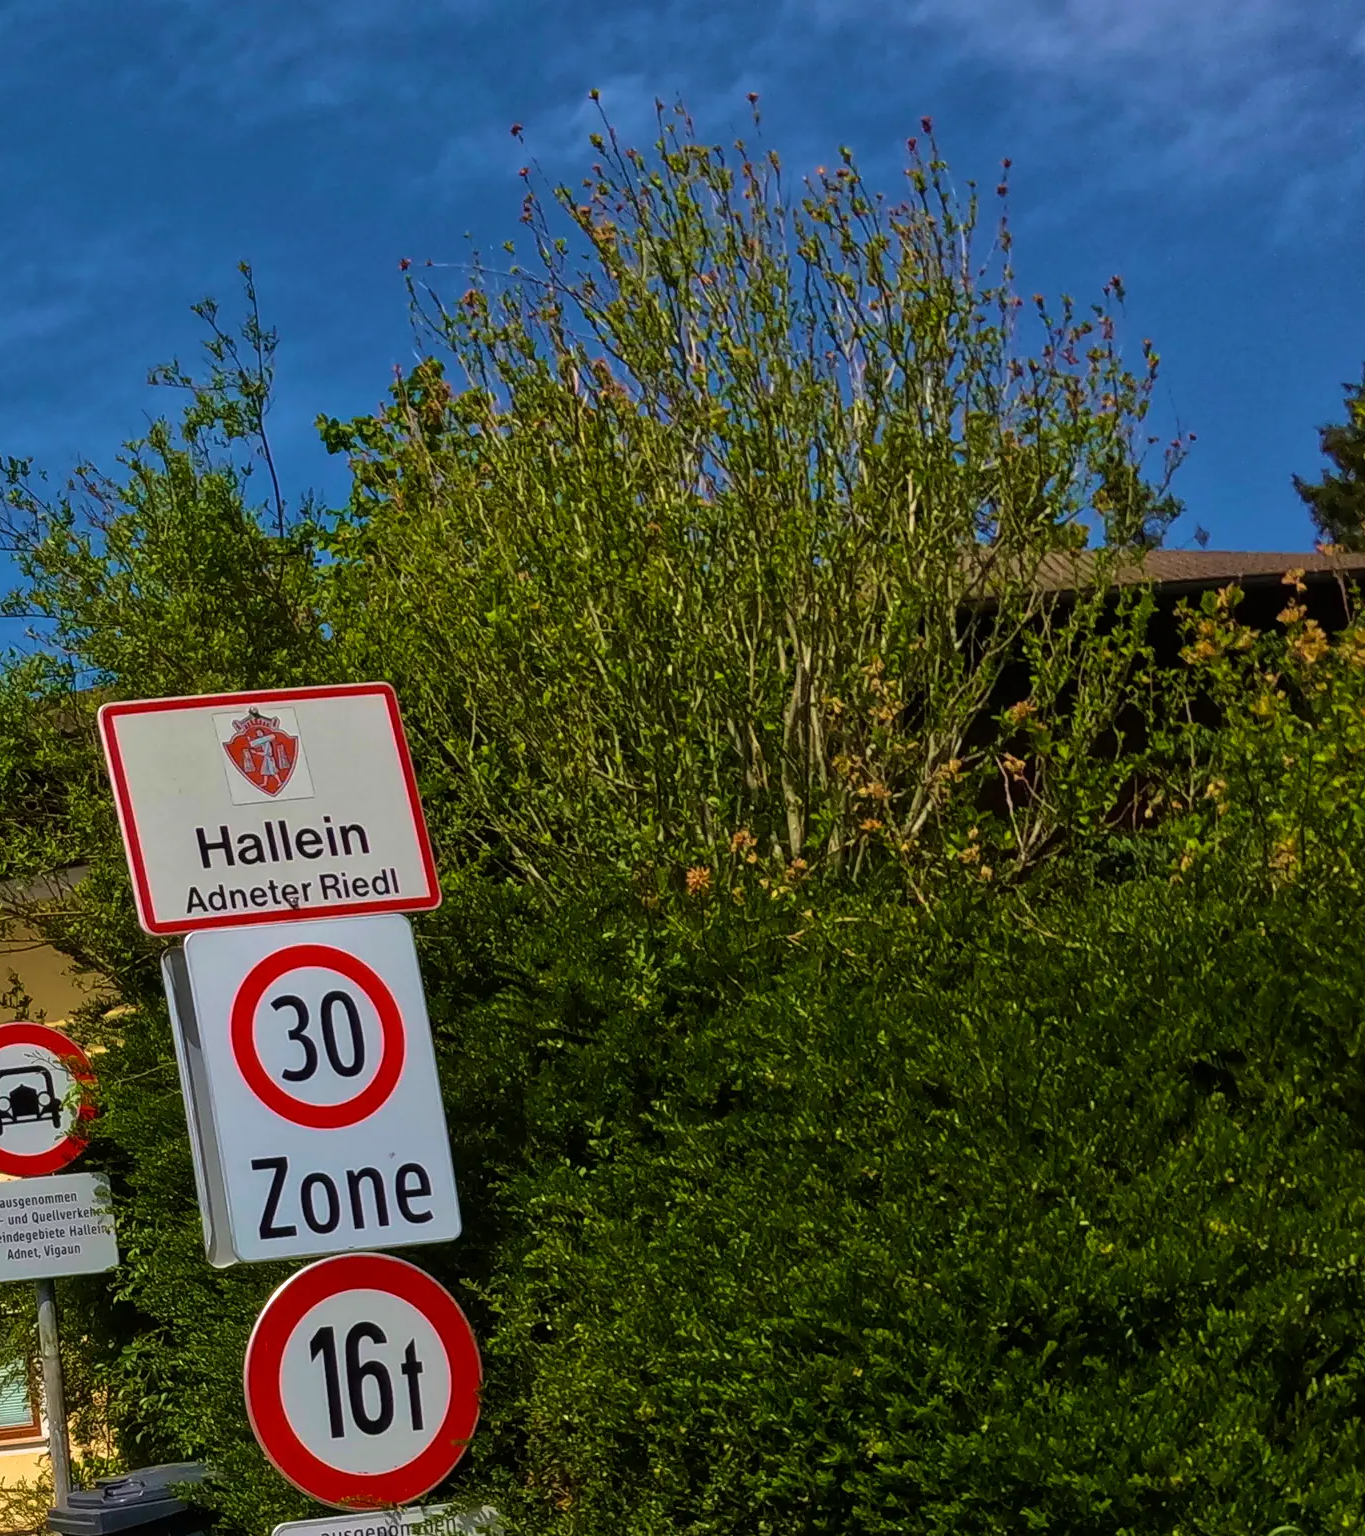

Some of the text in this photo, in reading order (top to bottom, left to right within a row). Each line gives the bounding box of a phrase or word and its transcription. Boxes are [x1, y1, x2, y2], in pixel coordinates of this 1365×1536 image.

[196, 815, 370, 869] Hallein
[186, 868, 400, 914] Adneter Riedl
[270, 990, 365, 1082] 30
[0, 1192, 78, 1210] ausgenommen
[7, 1213, 28, 1226] und
[250, 1156, 434, 1240] Zone
[7, 1243, 81, 1260] Adnet, Vigaun
